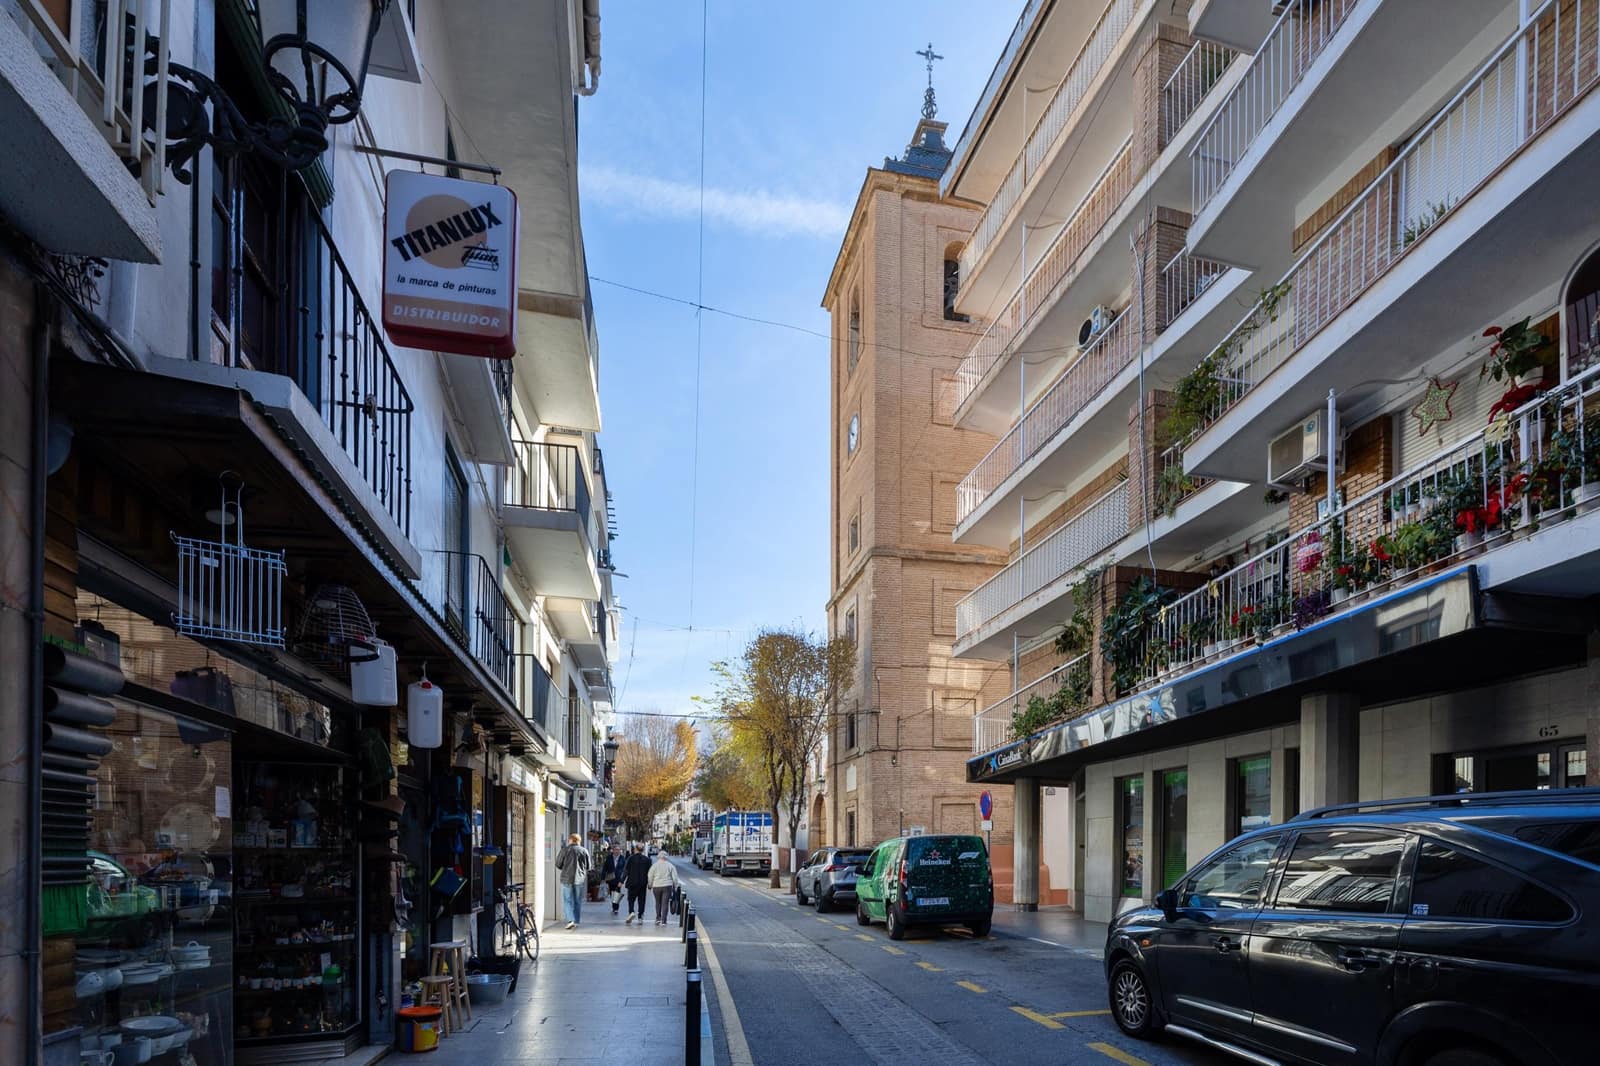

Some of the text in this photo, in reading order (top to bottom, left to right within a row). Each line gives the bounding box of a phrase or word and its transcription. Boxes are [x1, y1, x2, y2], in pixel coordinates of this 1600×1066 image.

[391, 202, 502, 262] TITANLUX
[461, 246, 499, 263] Titan
[397, 274, 496, 295] la marca de pinturas
[394, 305, 501, 327] DISTRIBUIDOR
